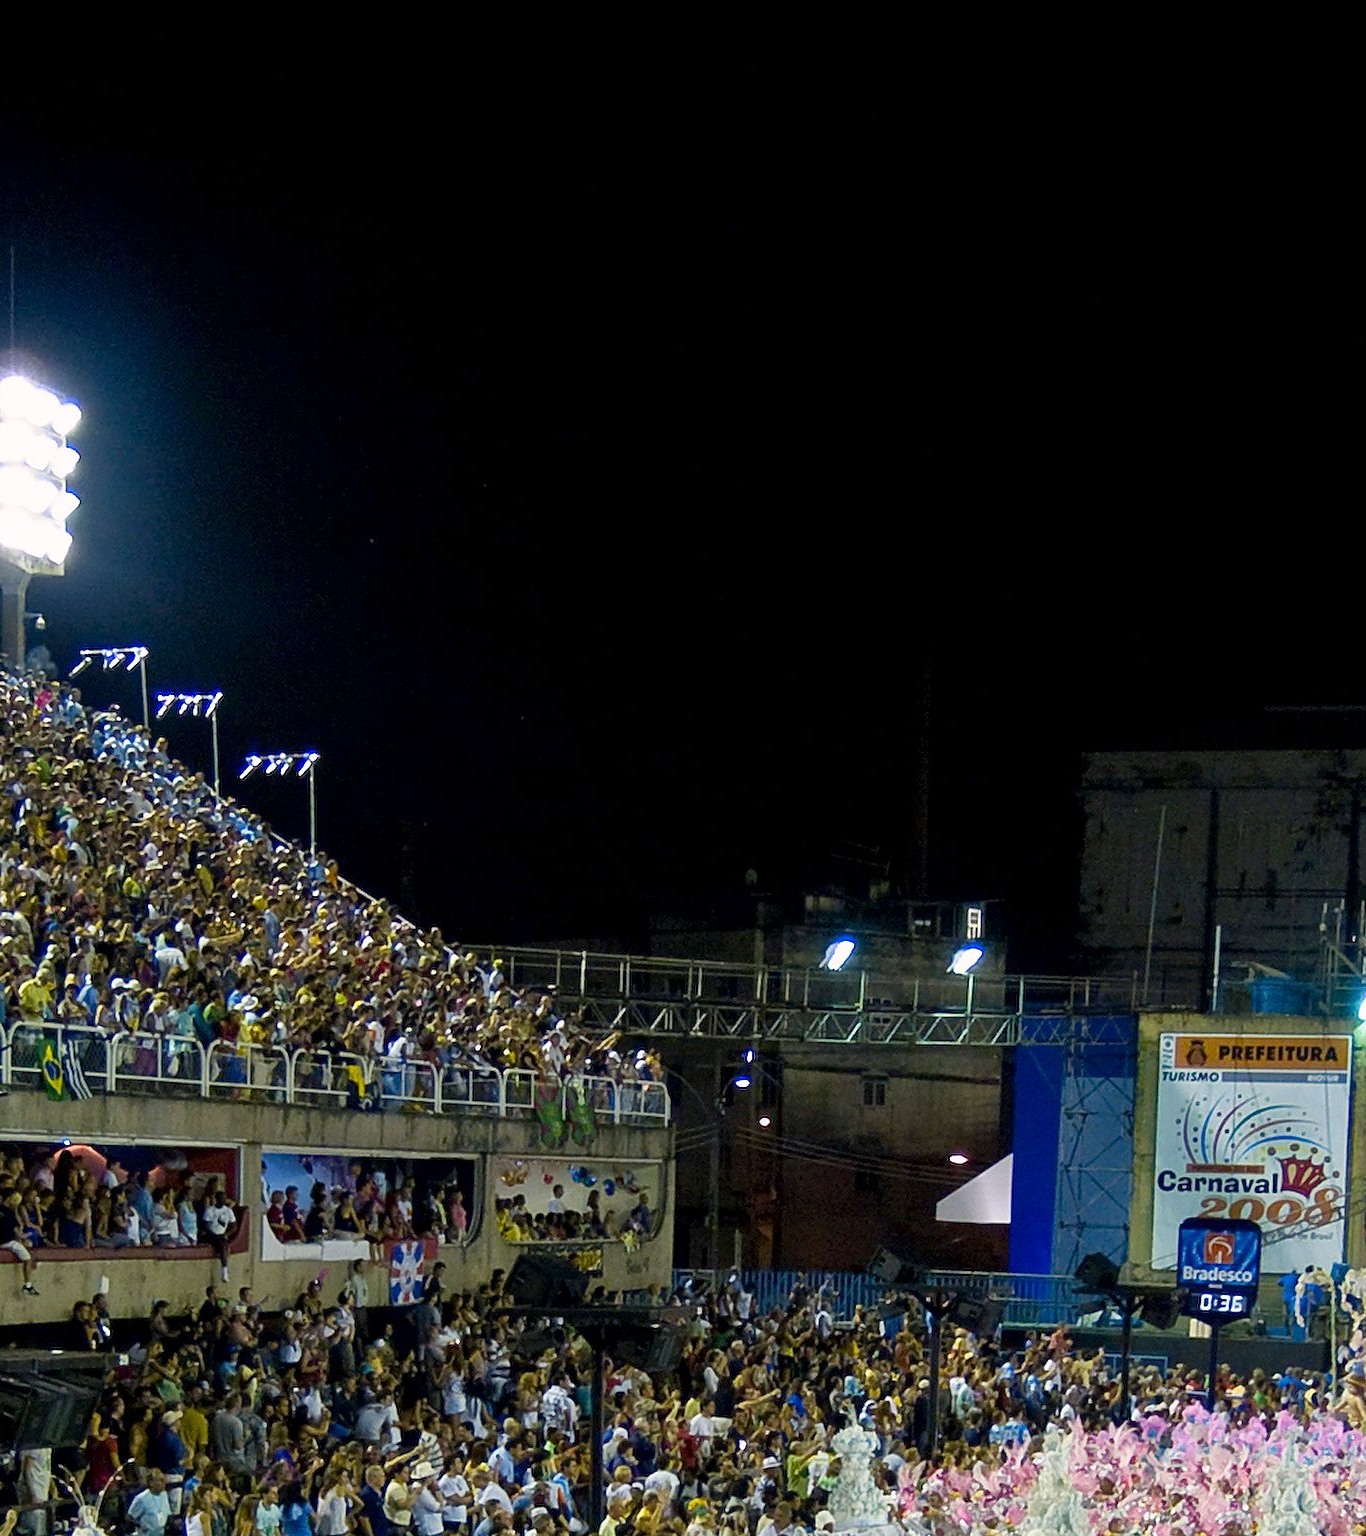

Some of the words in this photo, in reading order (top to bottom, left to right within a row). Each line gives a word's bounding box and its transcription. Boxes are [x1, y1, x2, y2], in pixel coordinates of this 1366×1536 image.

[1219, 1045, 1338, 1062] PREFEITURA
[1162, 1071, 1219, 1083] TURISMO
[1158, 1170, 1278, 1194] Carnaval
[1198, 1187, 1341, 1226] 2008
[1183, 1265, 1252, 1283] Bradesco
[1199, 1294, 1243, 1313] 0:36
